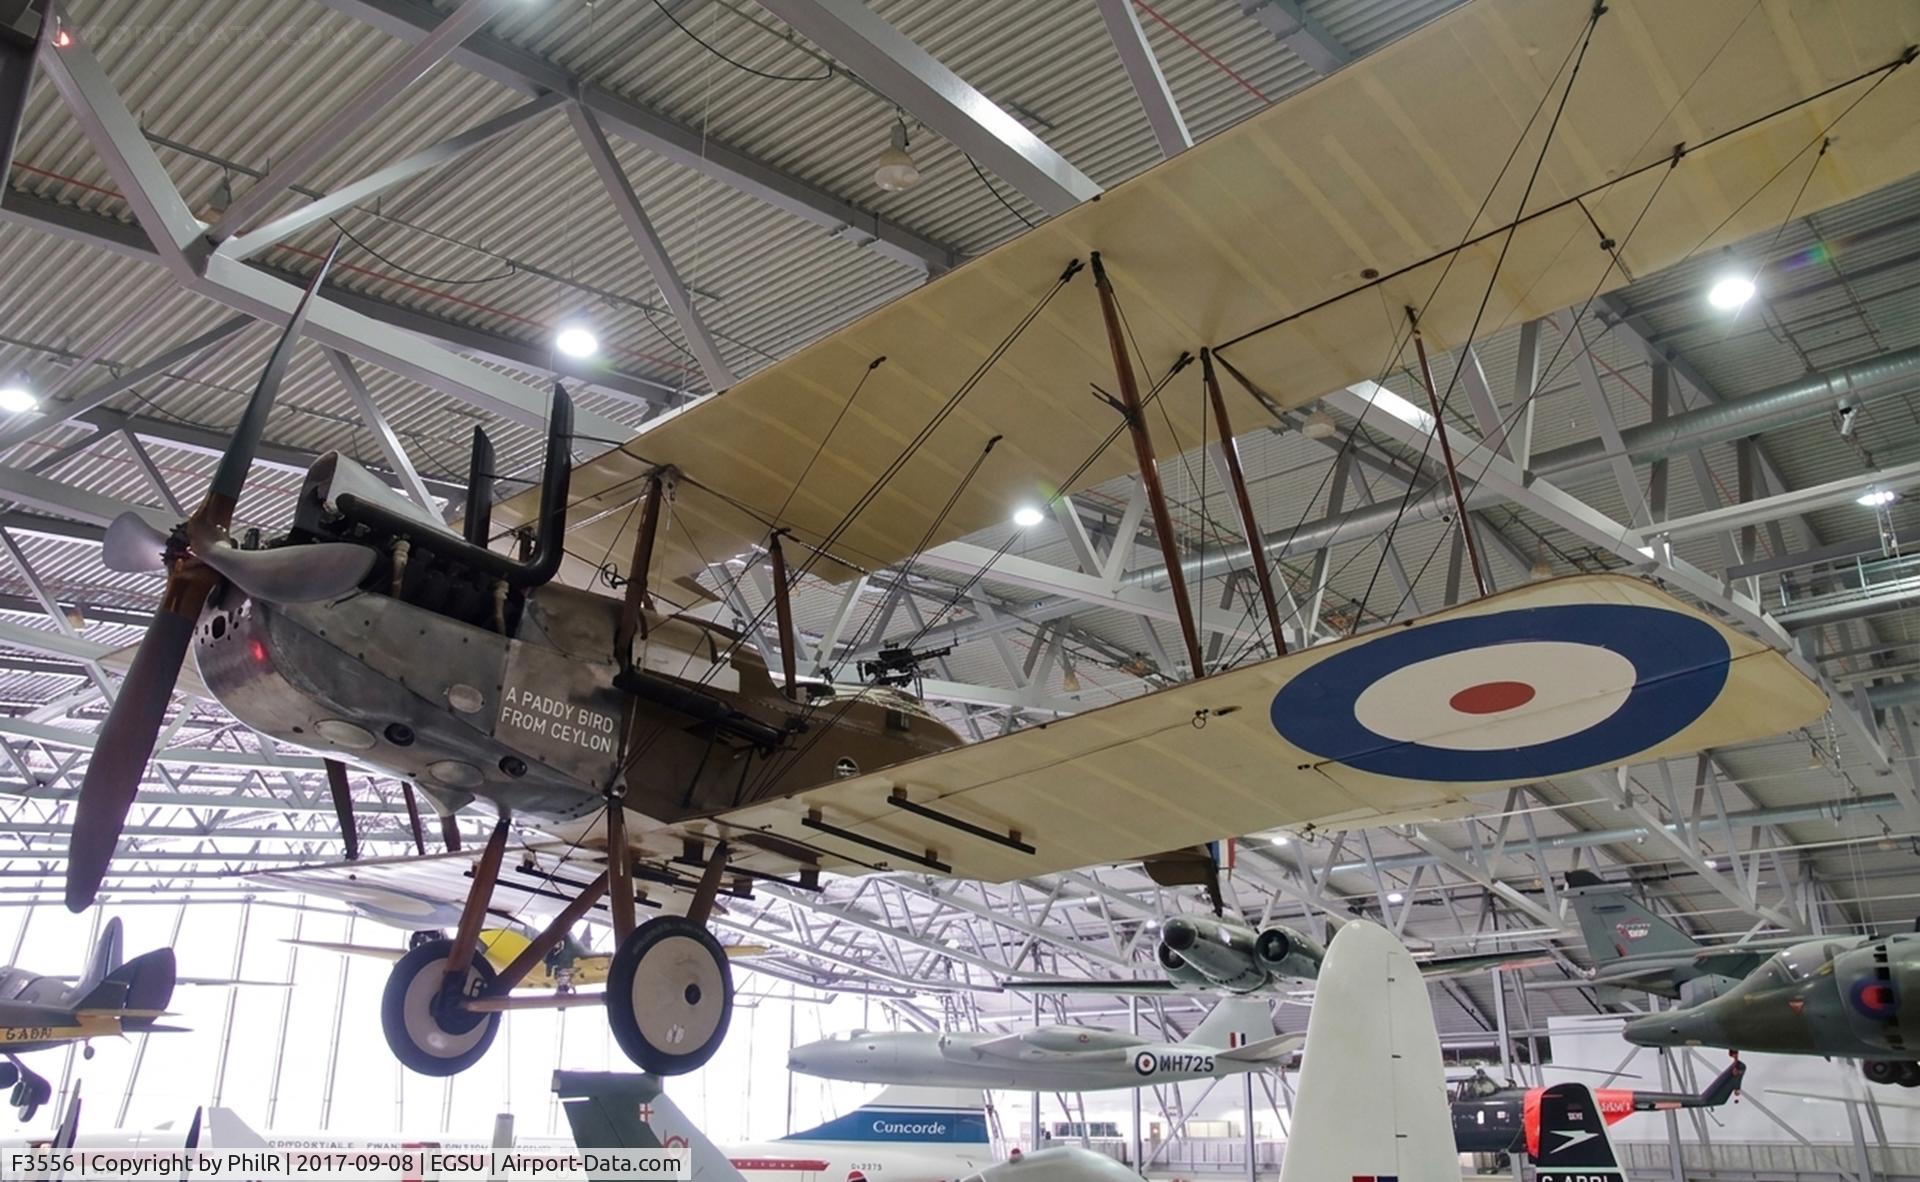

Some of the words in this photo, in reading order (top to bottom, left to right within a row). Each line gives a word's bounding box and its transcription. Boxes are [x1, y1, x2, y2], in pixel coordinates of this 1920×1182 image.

[501, 706, 547, 735] FROM
[551, 722, 613, 753] CEYLON
[505, 686, 517, 704] A
[521, 690, 575, 720] PADDY
[578, 708, 615, 734] BIRD
